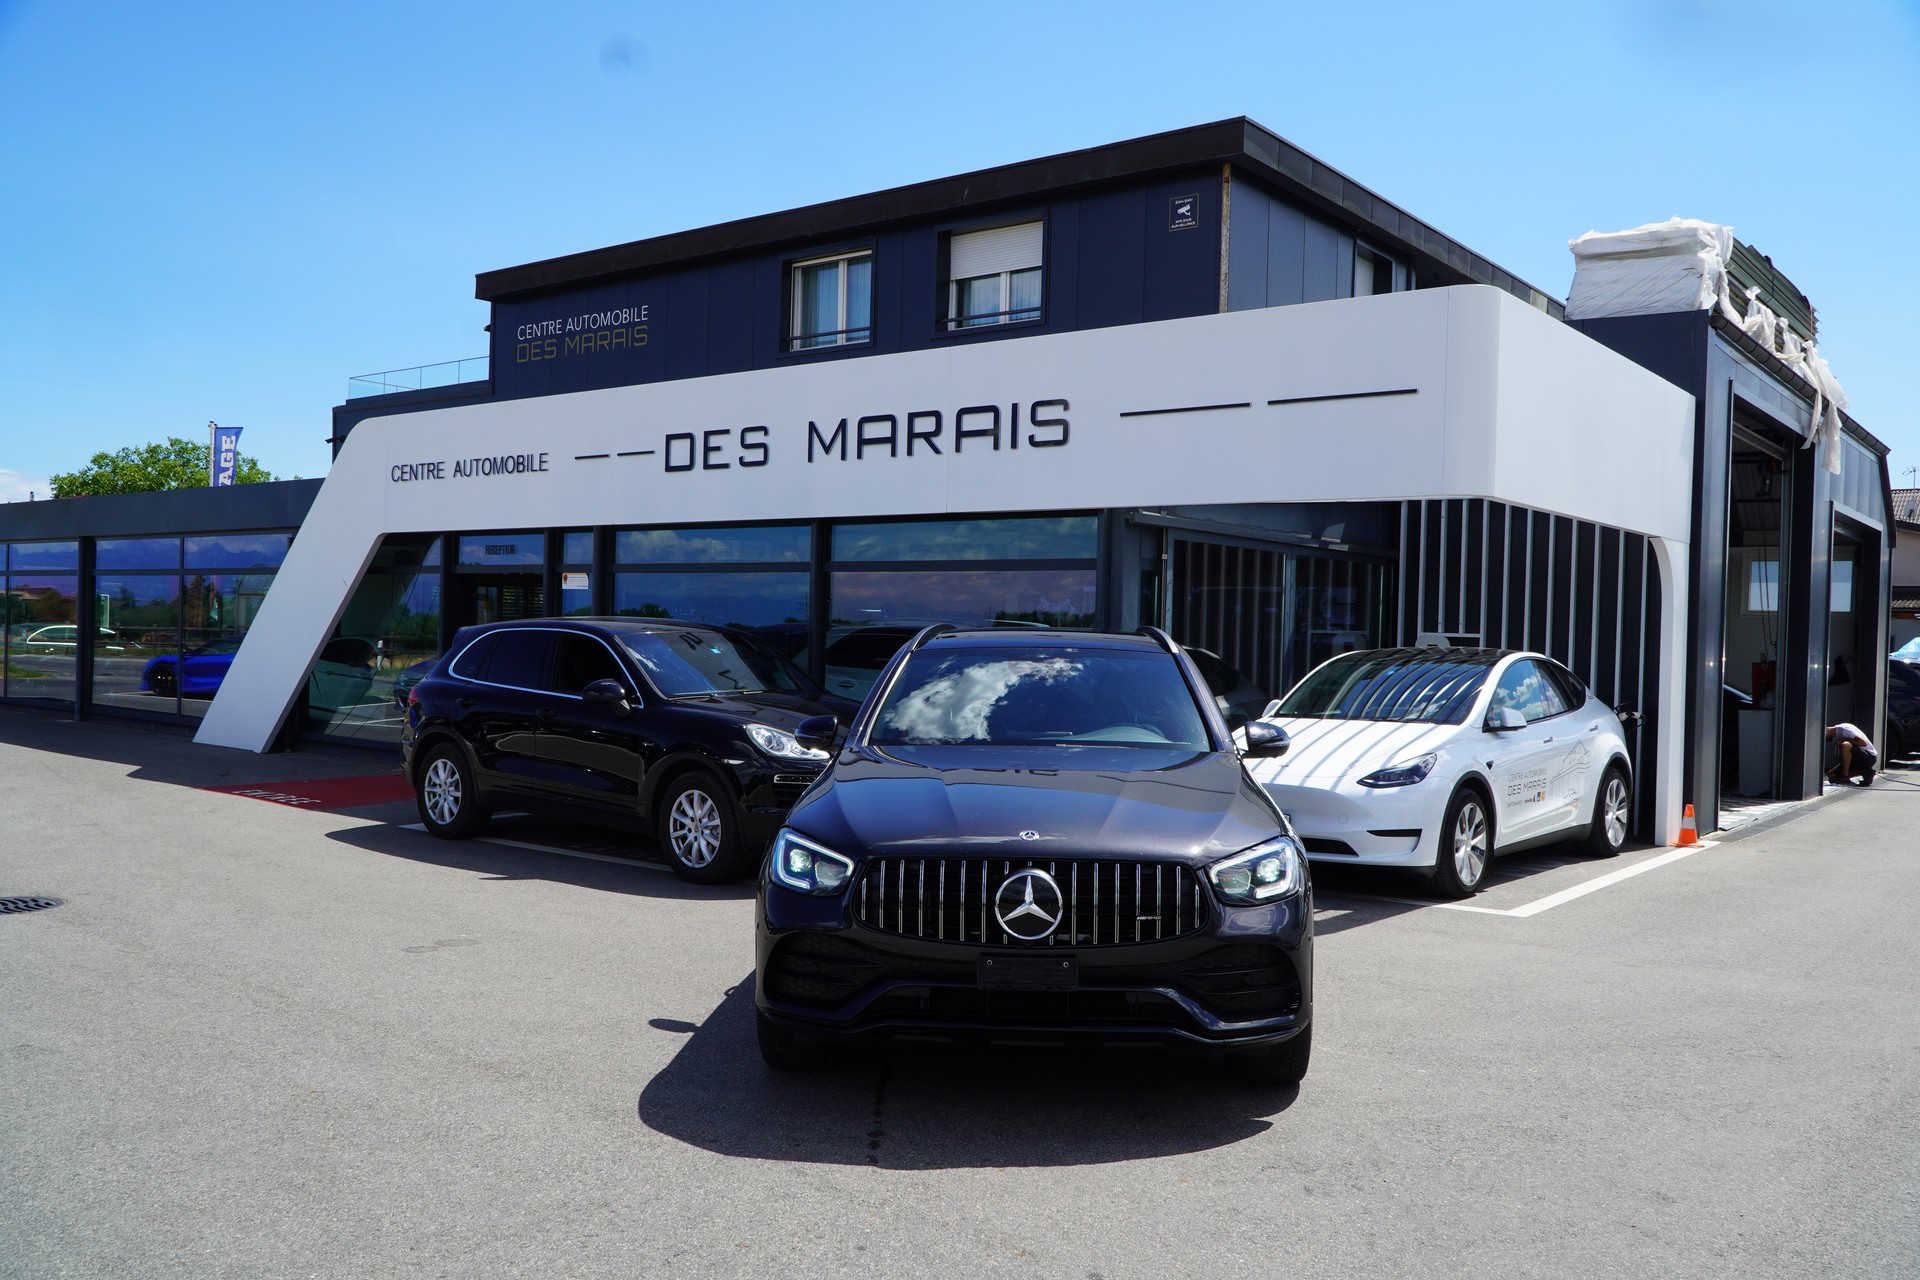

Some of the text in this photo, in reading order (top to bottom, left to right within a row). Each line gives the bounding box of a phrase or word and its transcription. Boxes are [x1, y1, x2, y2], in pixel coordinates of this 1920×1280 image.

[517, 305, 648, 340] CENTRE AUTOMOBILE
[516, 326, 648, 362] DES MARAIS
[391, 398, 1072, 483] CENTRE AUTOMOBILE DES MARAIS
[218, 436, 236, 486] AGE
[485, 544, 516, 555] RECEPTION
[1508, 784, 1522, 796] DES
